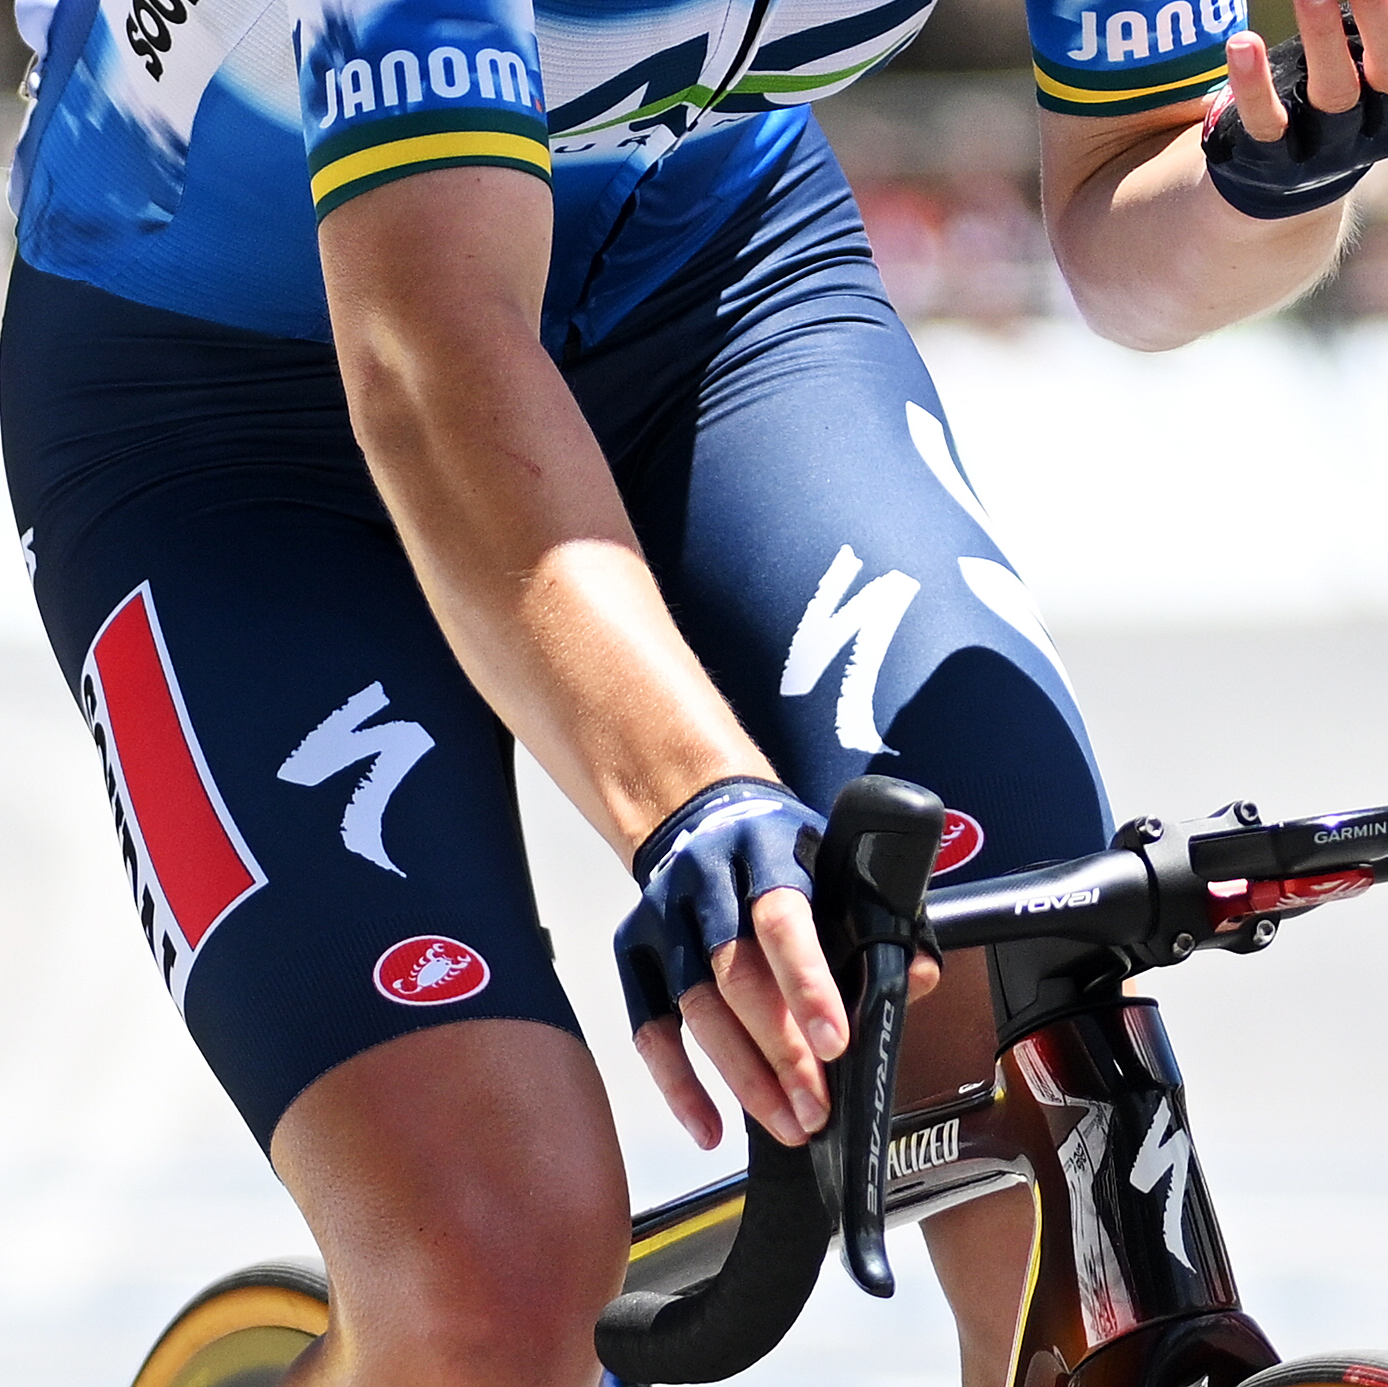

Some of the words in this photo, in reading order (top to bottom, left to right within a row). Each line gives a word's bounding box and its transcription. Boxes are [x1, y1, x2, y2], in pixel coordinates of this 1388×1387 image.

[1314, 821, 1387, 844] GARMIN
[1014, 887, 1100, 916] roval
[867, 999, 895, 1216] DURA-ACE
